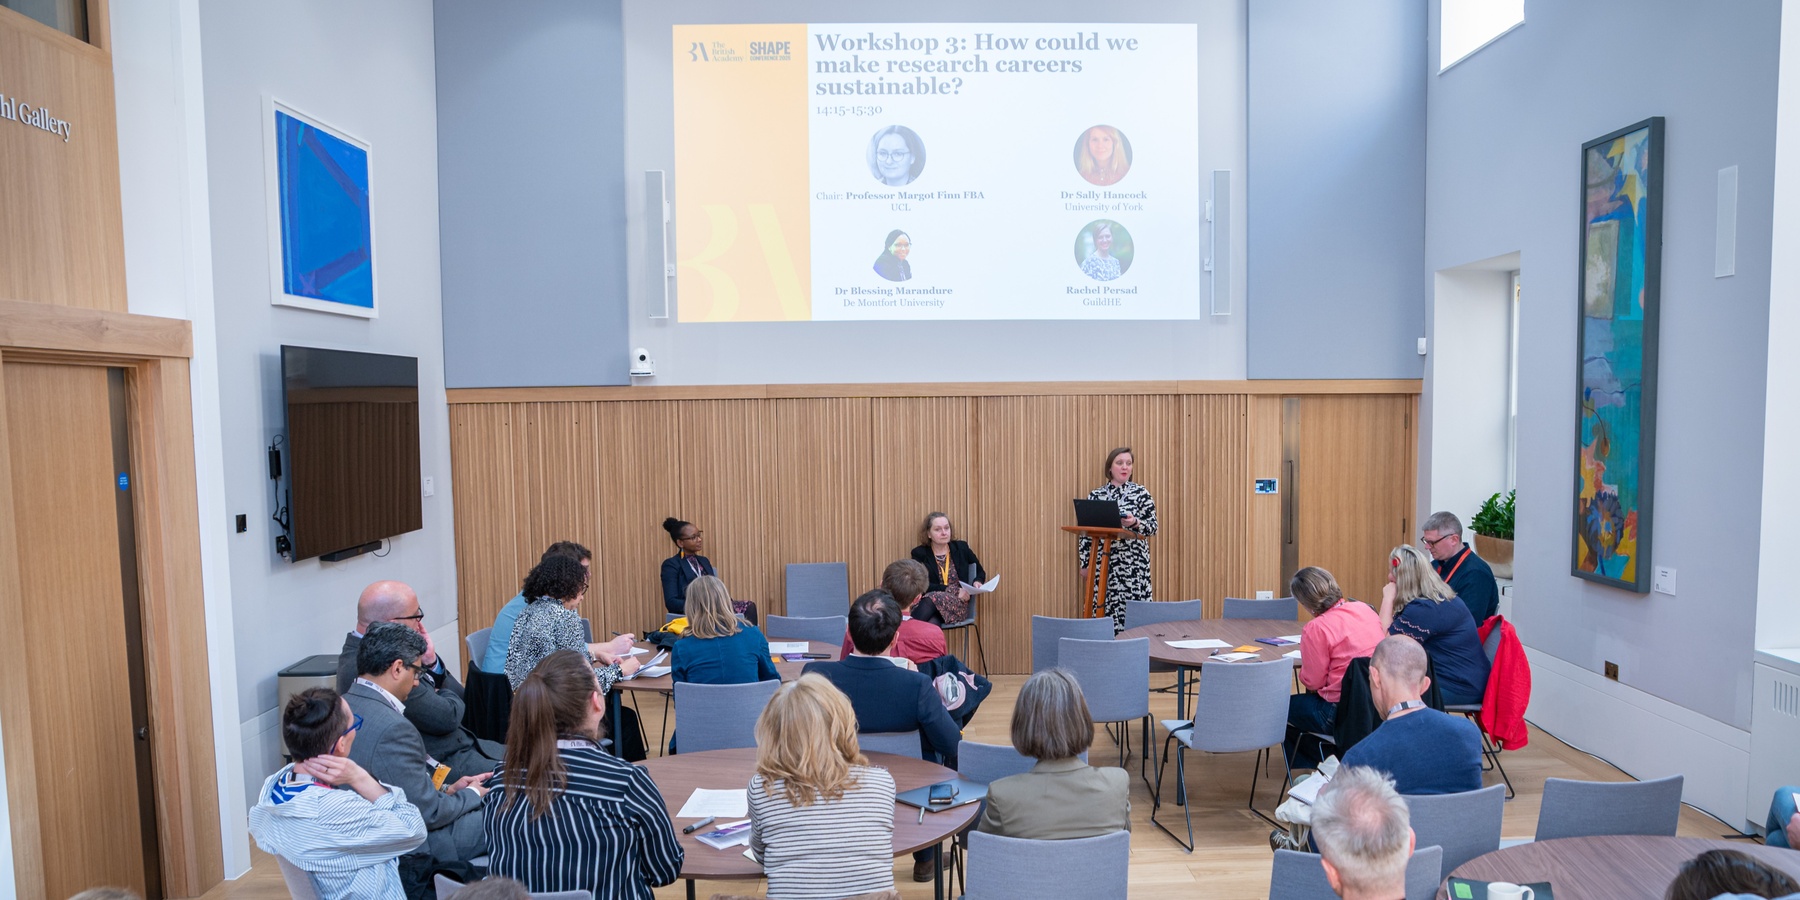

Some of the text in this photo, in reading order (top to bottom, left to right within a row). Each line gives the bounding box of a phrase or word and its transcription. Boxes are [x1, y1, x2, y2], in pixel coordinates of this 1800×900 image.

[749, 41, 791, 55] SHAPE
[814, 31, 1139, 55] Workshop 3: How could we
[711, 55, 744, 63] Academy
[815, 54, 1083, 74] make research careers
[815, 76, 964, 96] sustainable?
[816, 105, 883, 117] 14:15-15:30
[18, 102, 71, 143] Gallery
[816, 190, 985, 202] Chair: Professor Margot Finn FBA
[1060, 190, 1148, 202] Dr Sally Hancock
[891, 202, 912, 212] UCL
[1064, 202, 1144, 213] University of York
[834, 286, 953, 298] Dr Blessing Marandure
[1066, 286, 1138, 295] Rachel Persad
[843, 297, 945, 309] De Montfort University
[1082, 297, 1122, 307] GuildHE
